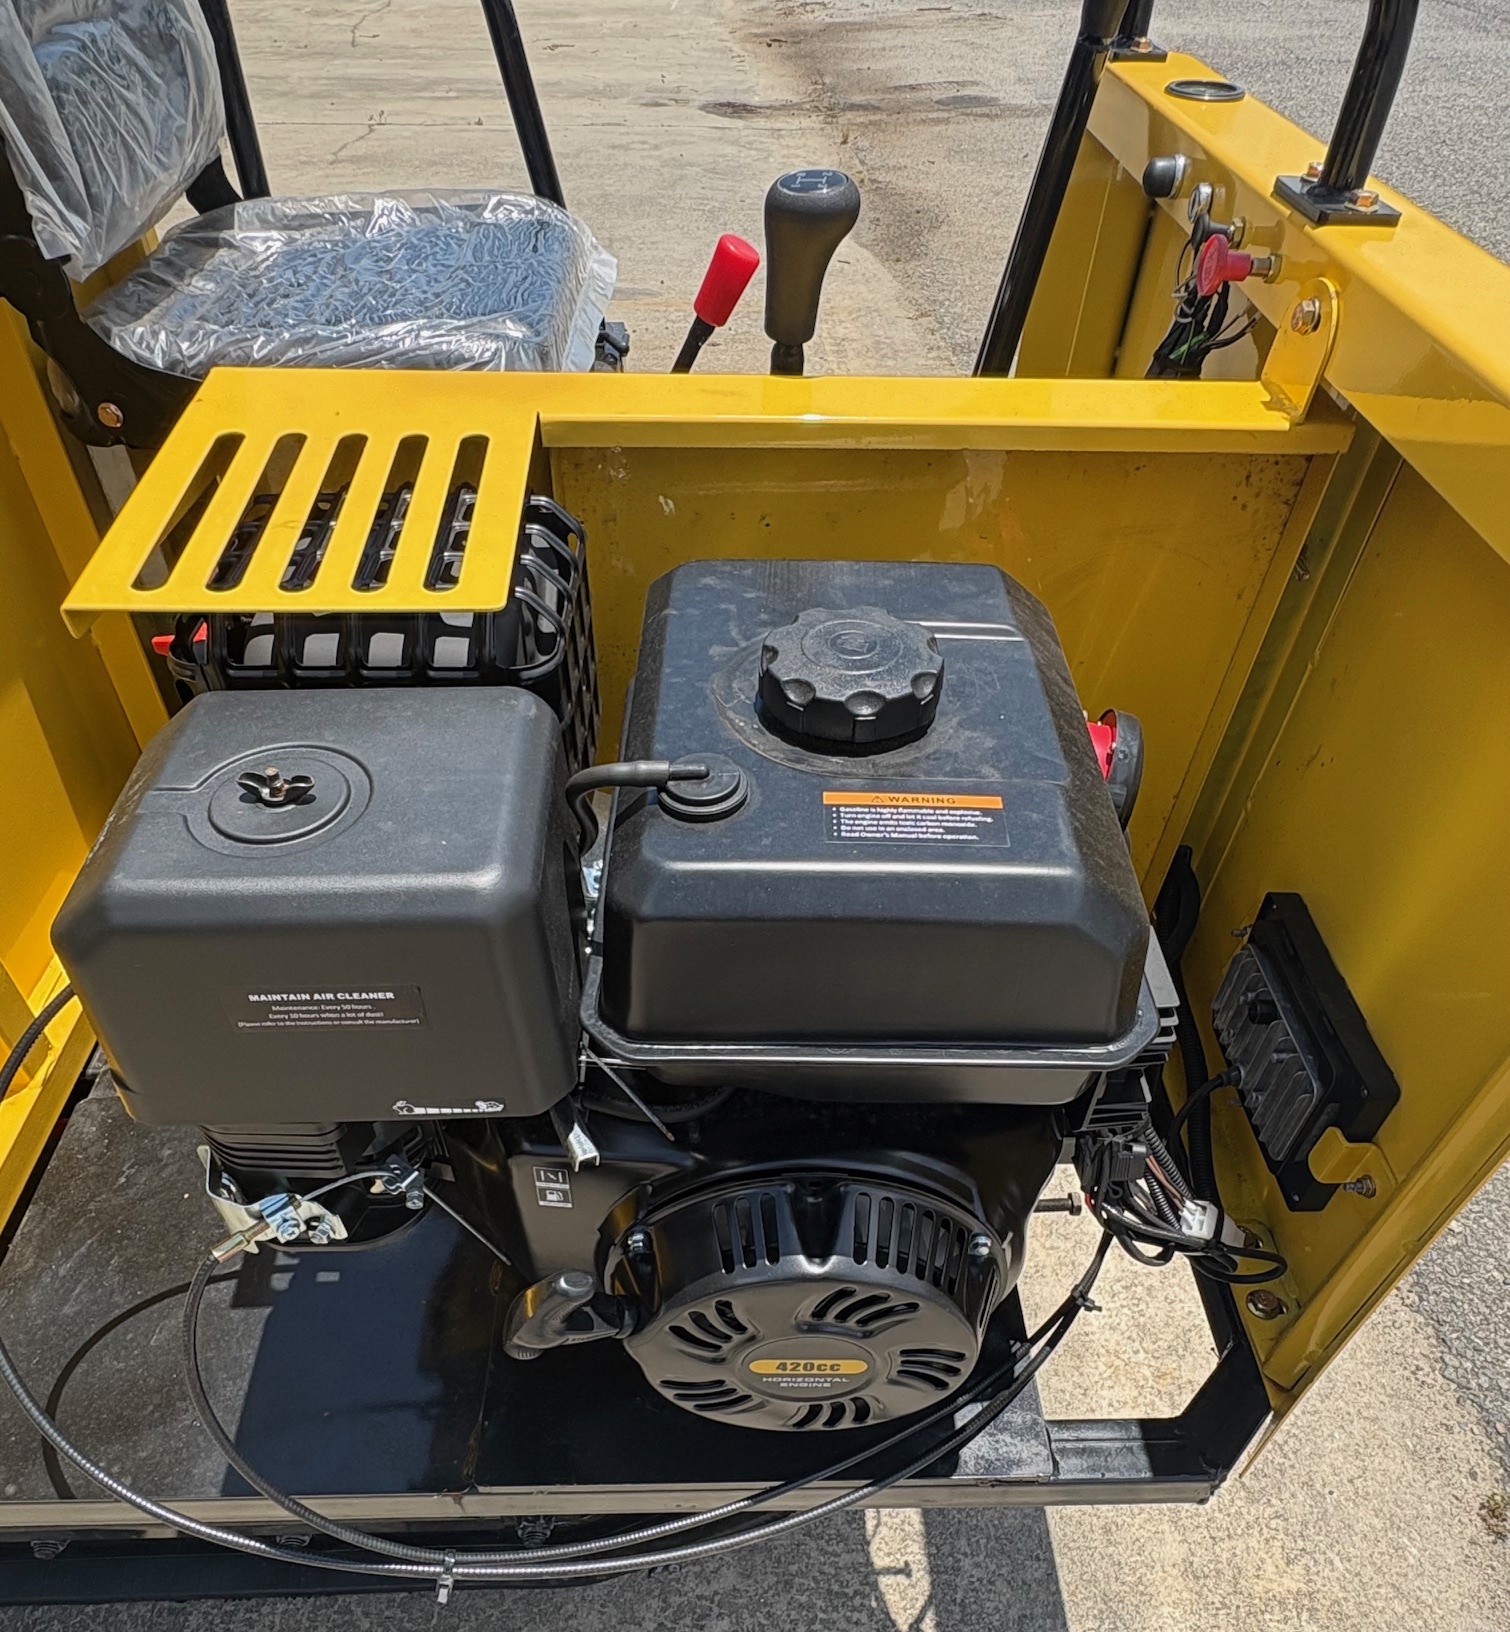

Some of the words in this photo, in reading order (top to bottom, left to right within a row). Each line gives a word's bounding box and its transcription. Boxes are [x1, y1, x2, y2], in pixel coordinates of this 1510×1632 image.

[888, 796, 956, 805] WARNING
[248, 993, 311, 1002] MAINTAIN
[313, 992, 335, 1001] AIR
[336, 991, 395, 1000] CLEANER
[775, 1361, 842, 1372] 420cc
